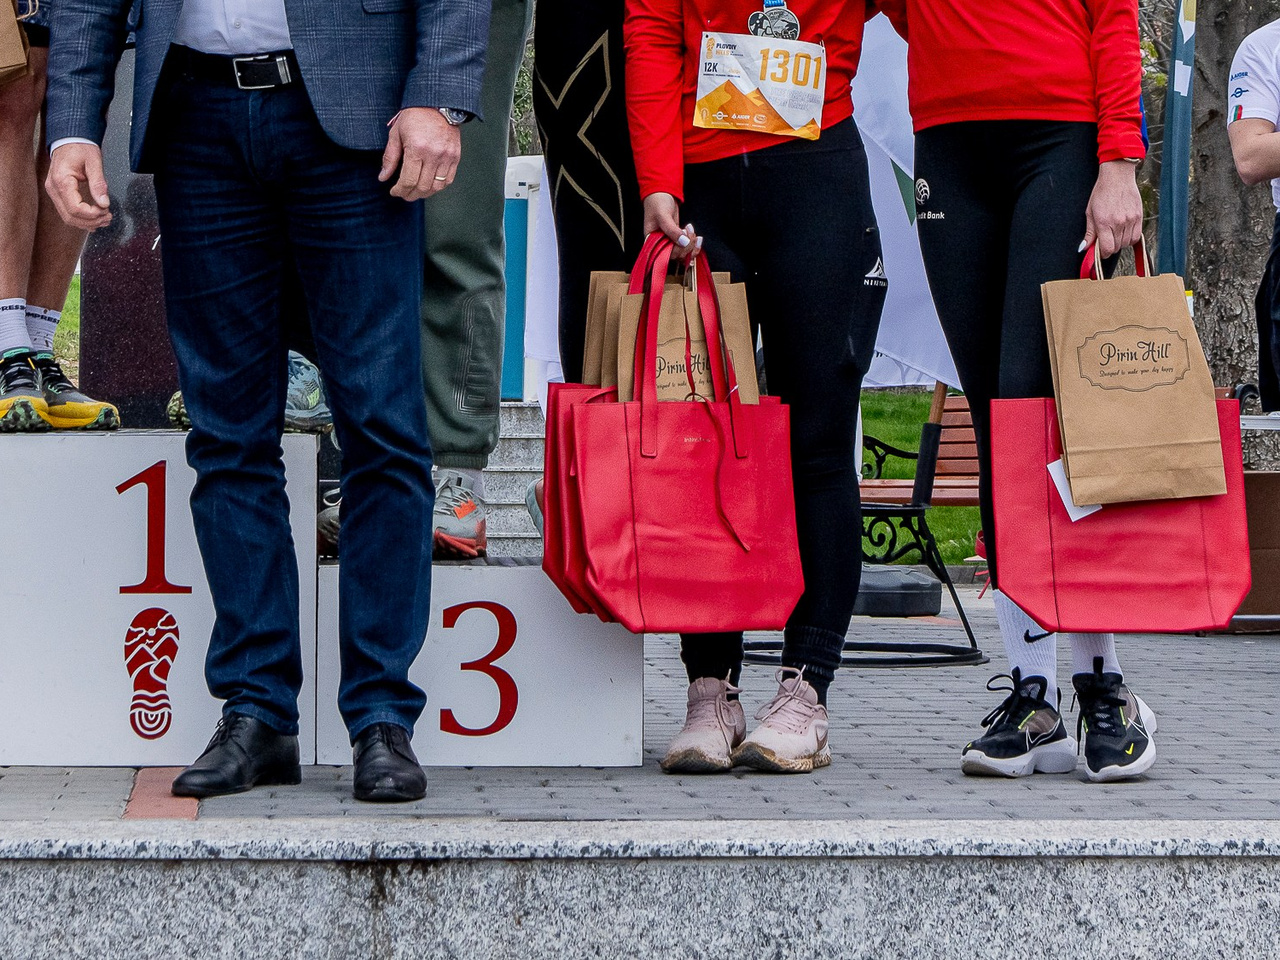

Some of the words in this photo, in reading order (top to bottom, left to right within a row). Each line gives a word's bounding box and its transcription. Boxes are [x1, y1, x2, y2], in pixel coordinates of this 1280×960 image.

[704, 62, 718, 73] 12K
[758, 47, 822, 90] 1301
[1100, 342, 1138, 366] Pirin
[1137, 341, 1170, 362] Hill
[115, 460, 192, 595] 1
[439, 600, 519, 737] 3
